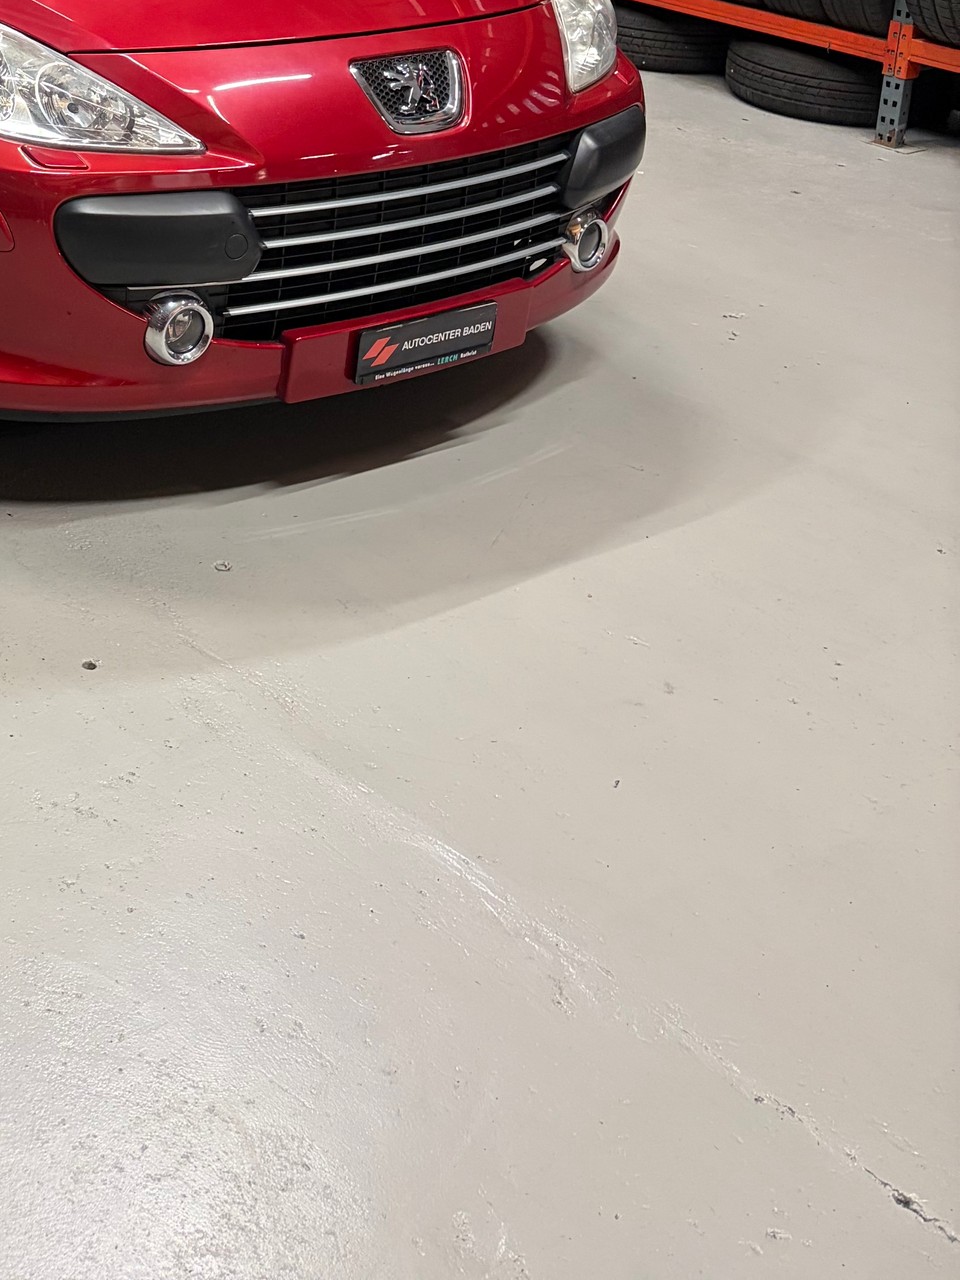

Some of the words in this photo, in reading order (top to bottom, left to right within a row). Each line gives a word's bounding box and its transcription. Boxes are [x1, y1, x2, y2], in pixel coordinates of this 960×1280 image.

[401, 328, 461, 351] AUTOCENTER
[462, 320, 493, 337] BADEN
[436, 353, 459, 366] LERCH
